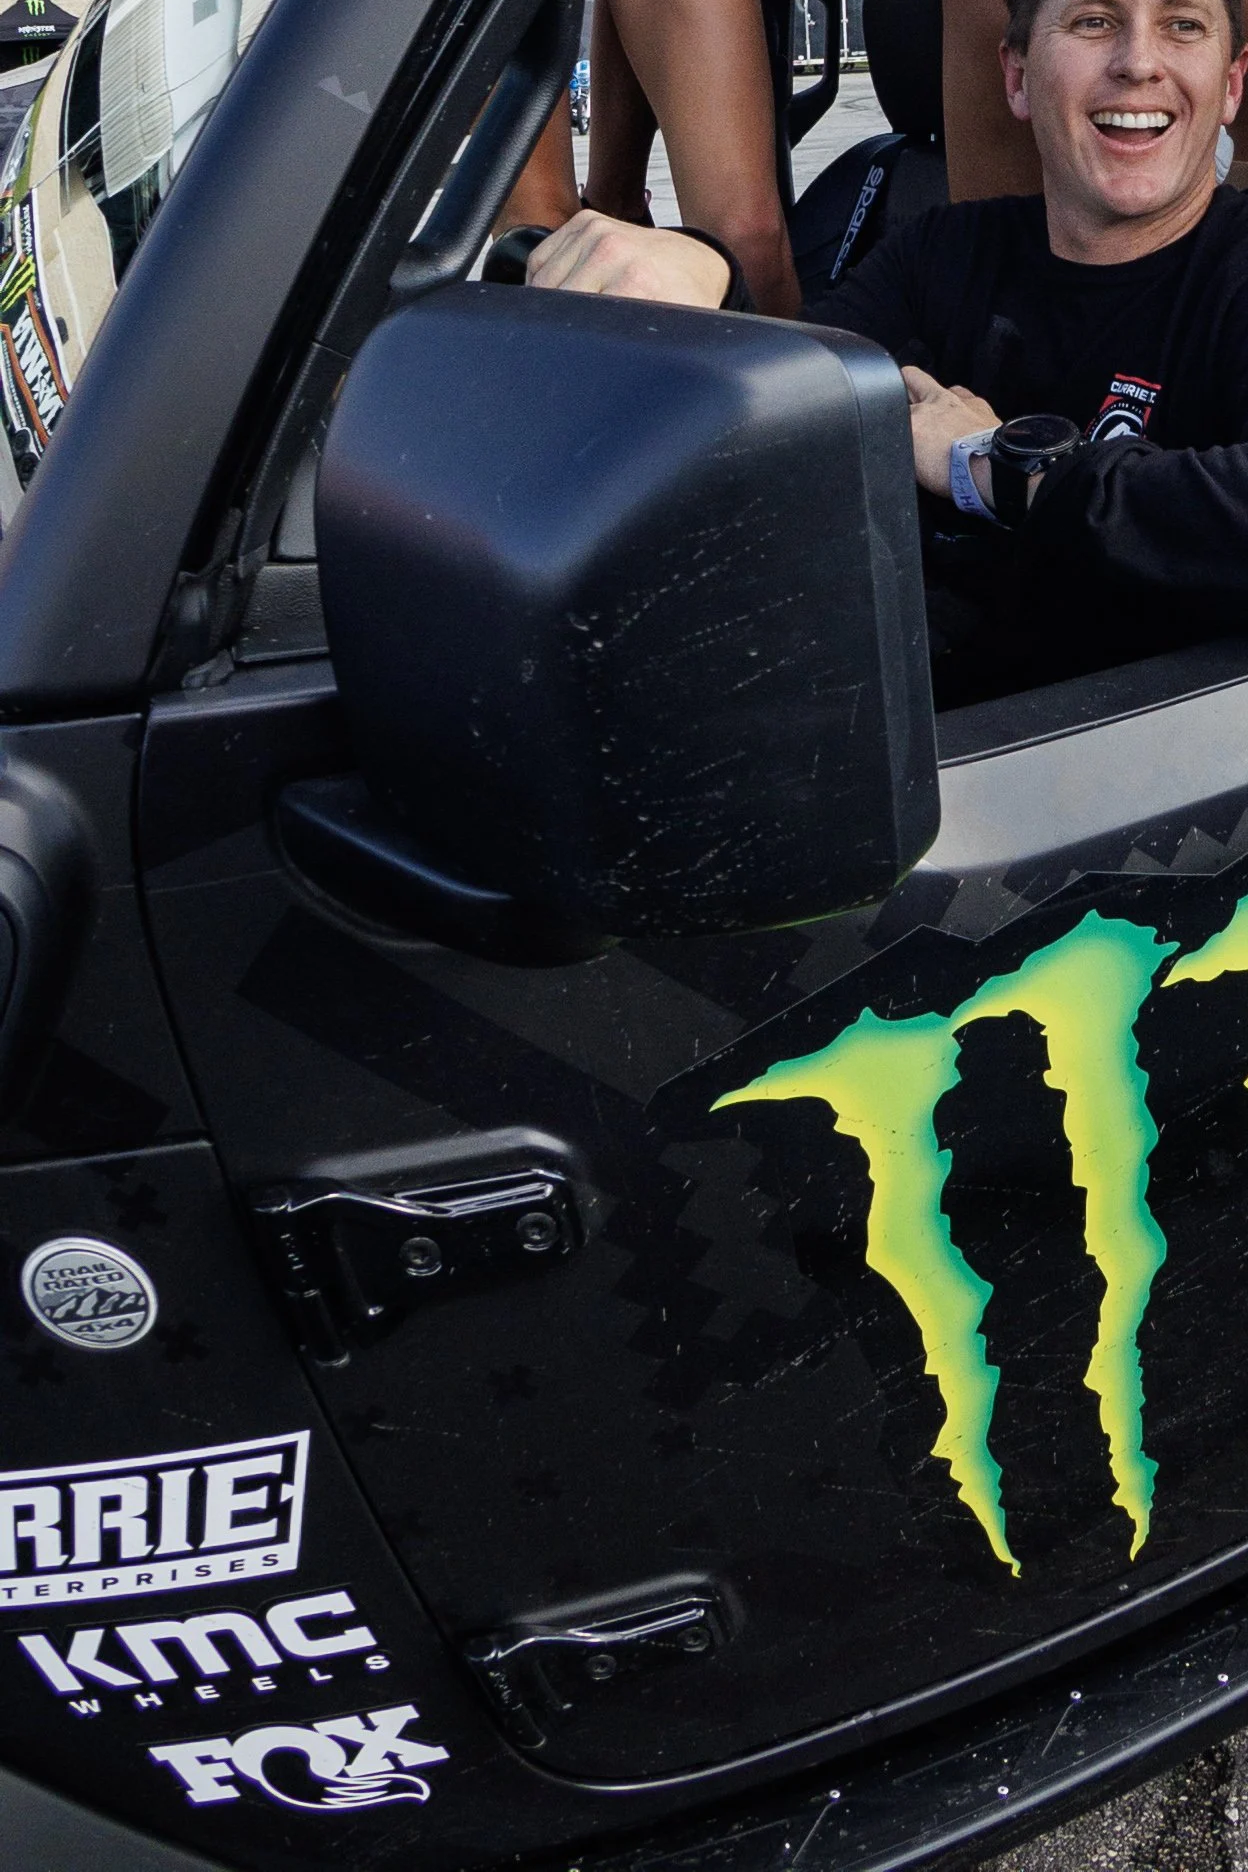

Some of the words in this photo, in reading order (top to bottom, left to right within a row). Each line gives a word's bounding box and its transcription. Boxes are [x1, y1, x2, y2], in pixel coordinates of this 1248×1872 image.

[41, 1262, 116, 1280] TRAIL
[42, 1271, 125, 1292] RATED
[1, 1552, 280, 1600] TERPRISES
[69, 1654, 391, 1718] WHEELS
[147, 1704, 451, 1810] FOX
